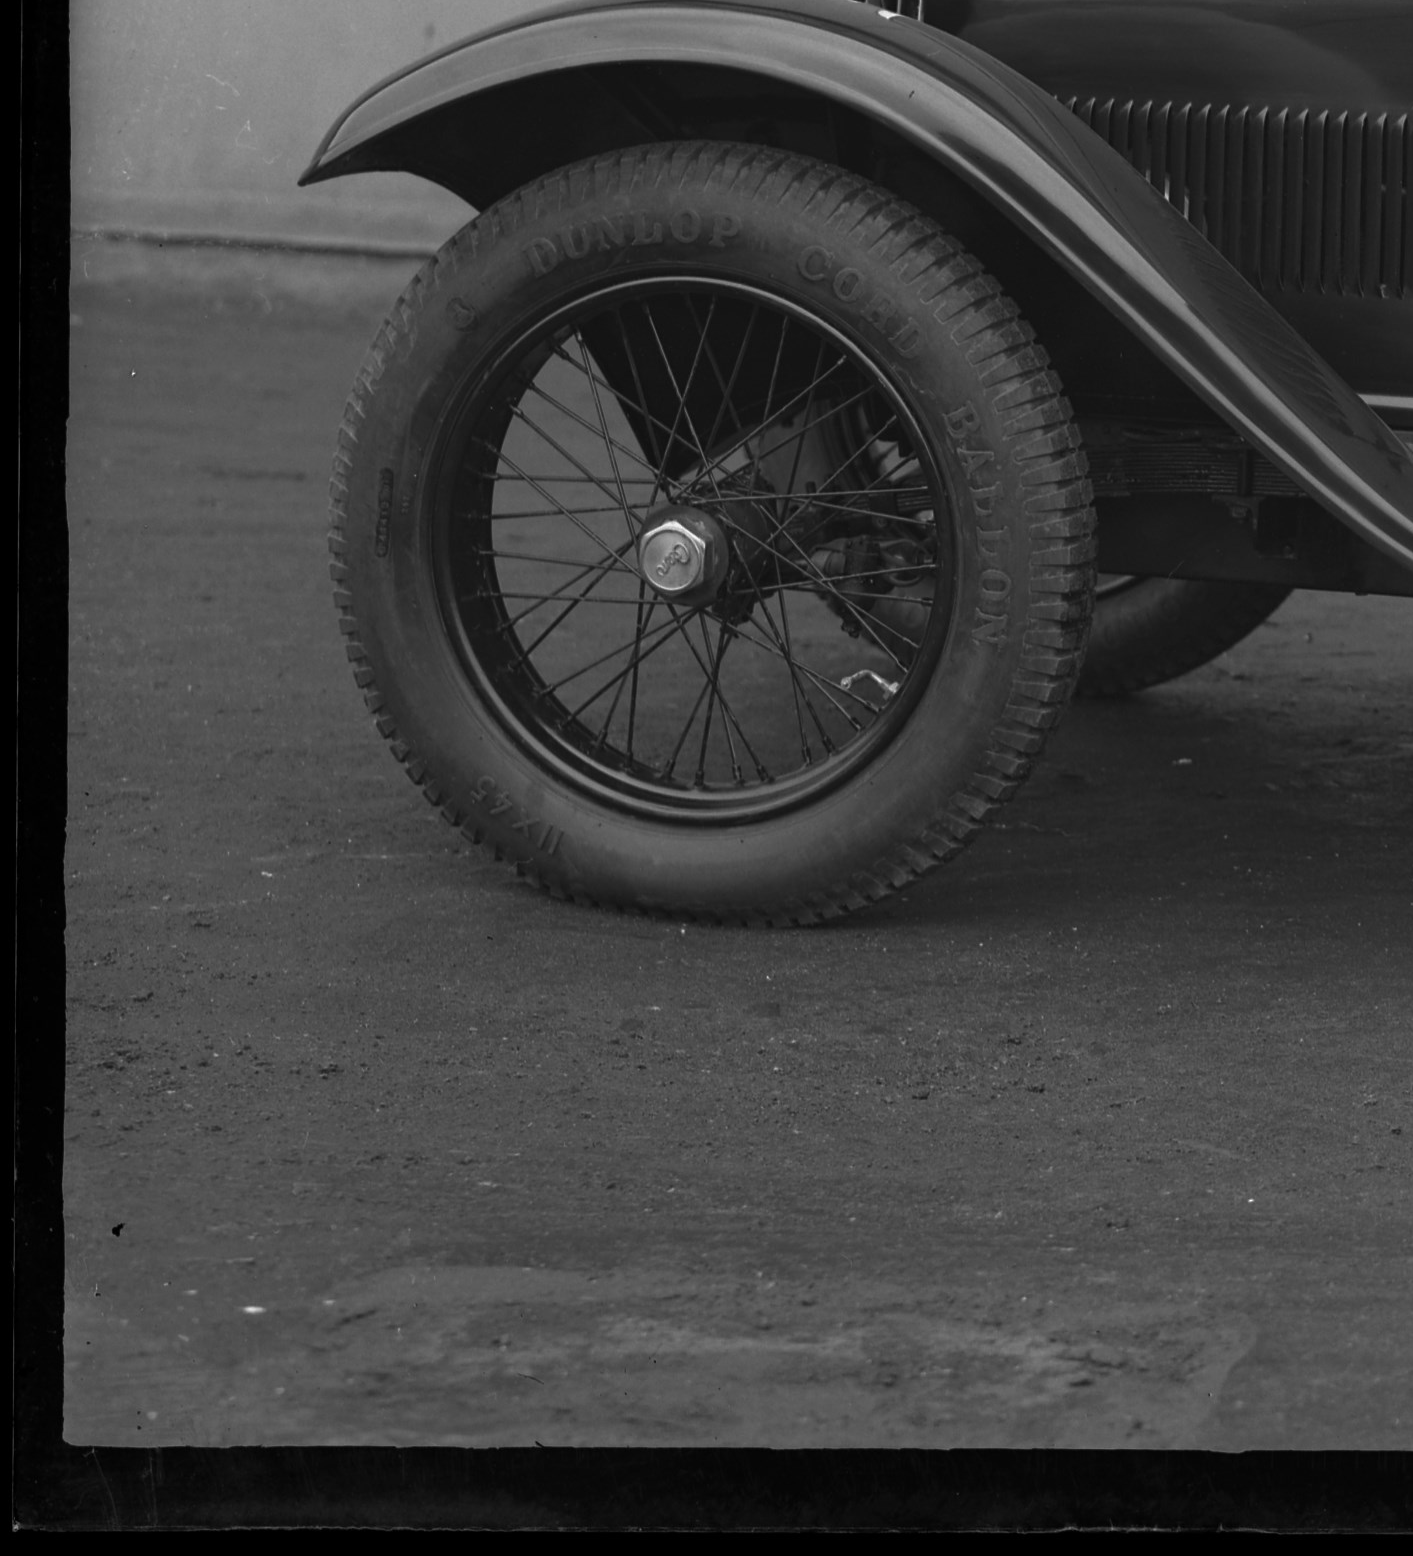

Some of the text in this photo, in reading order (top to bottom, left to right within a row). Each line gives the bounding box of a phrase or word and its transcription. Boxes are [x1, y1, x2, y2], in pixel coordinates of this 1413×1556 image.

[521, 209, 744, 279] DUNLOP
[797, 244, 925, 361] CORD
[942, 399, 1012, 650] BALLON
